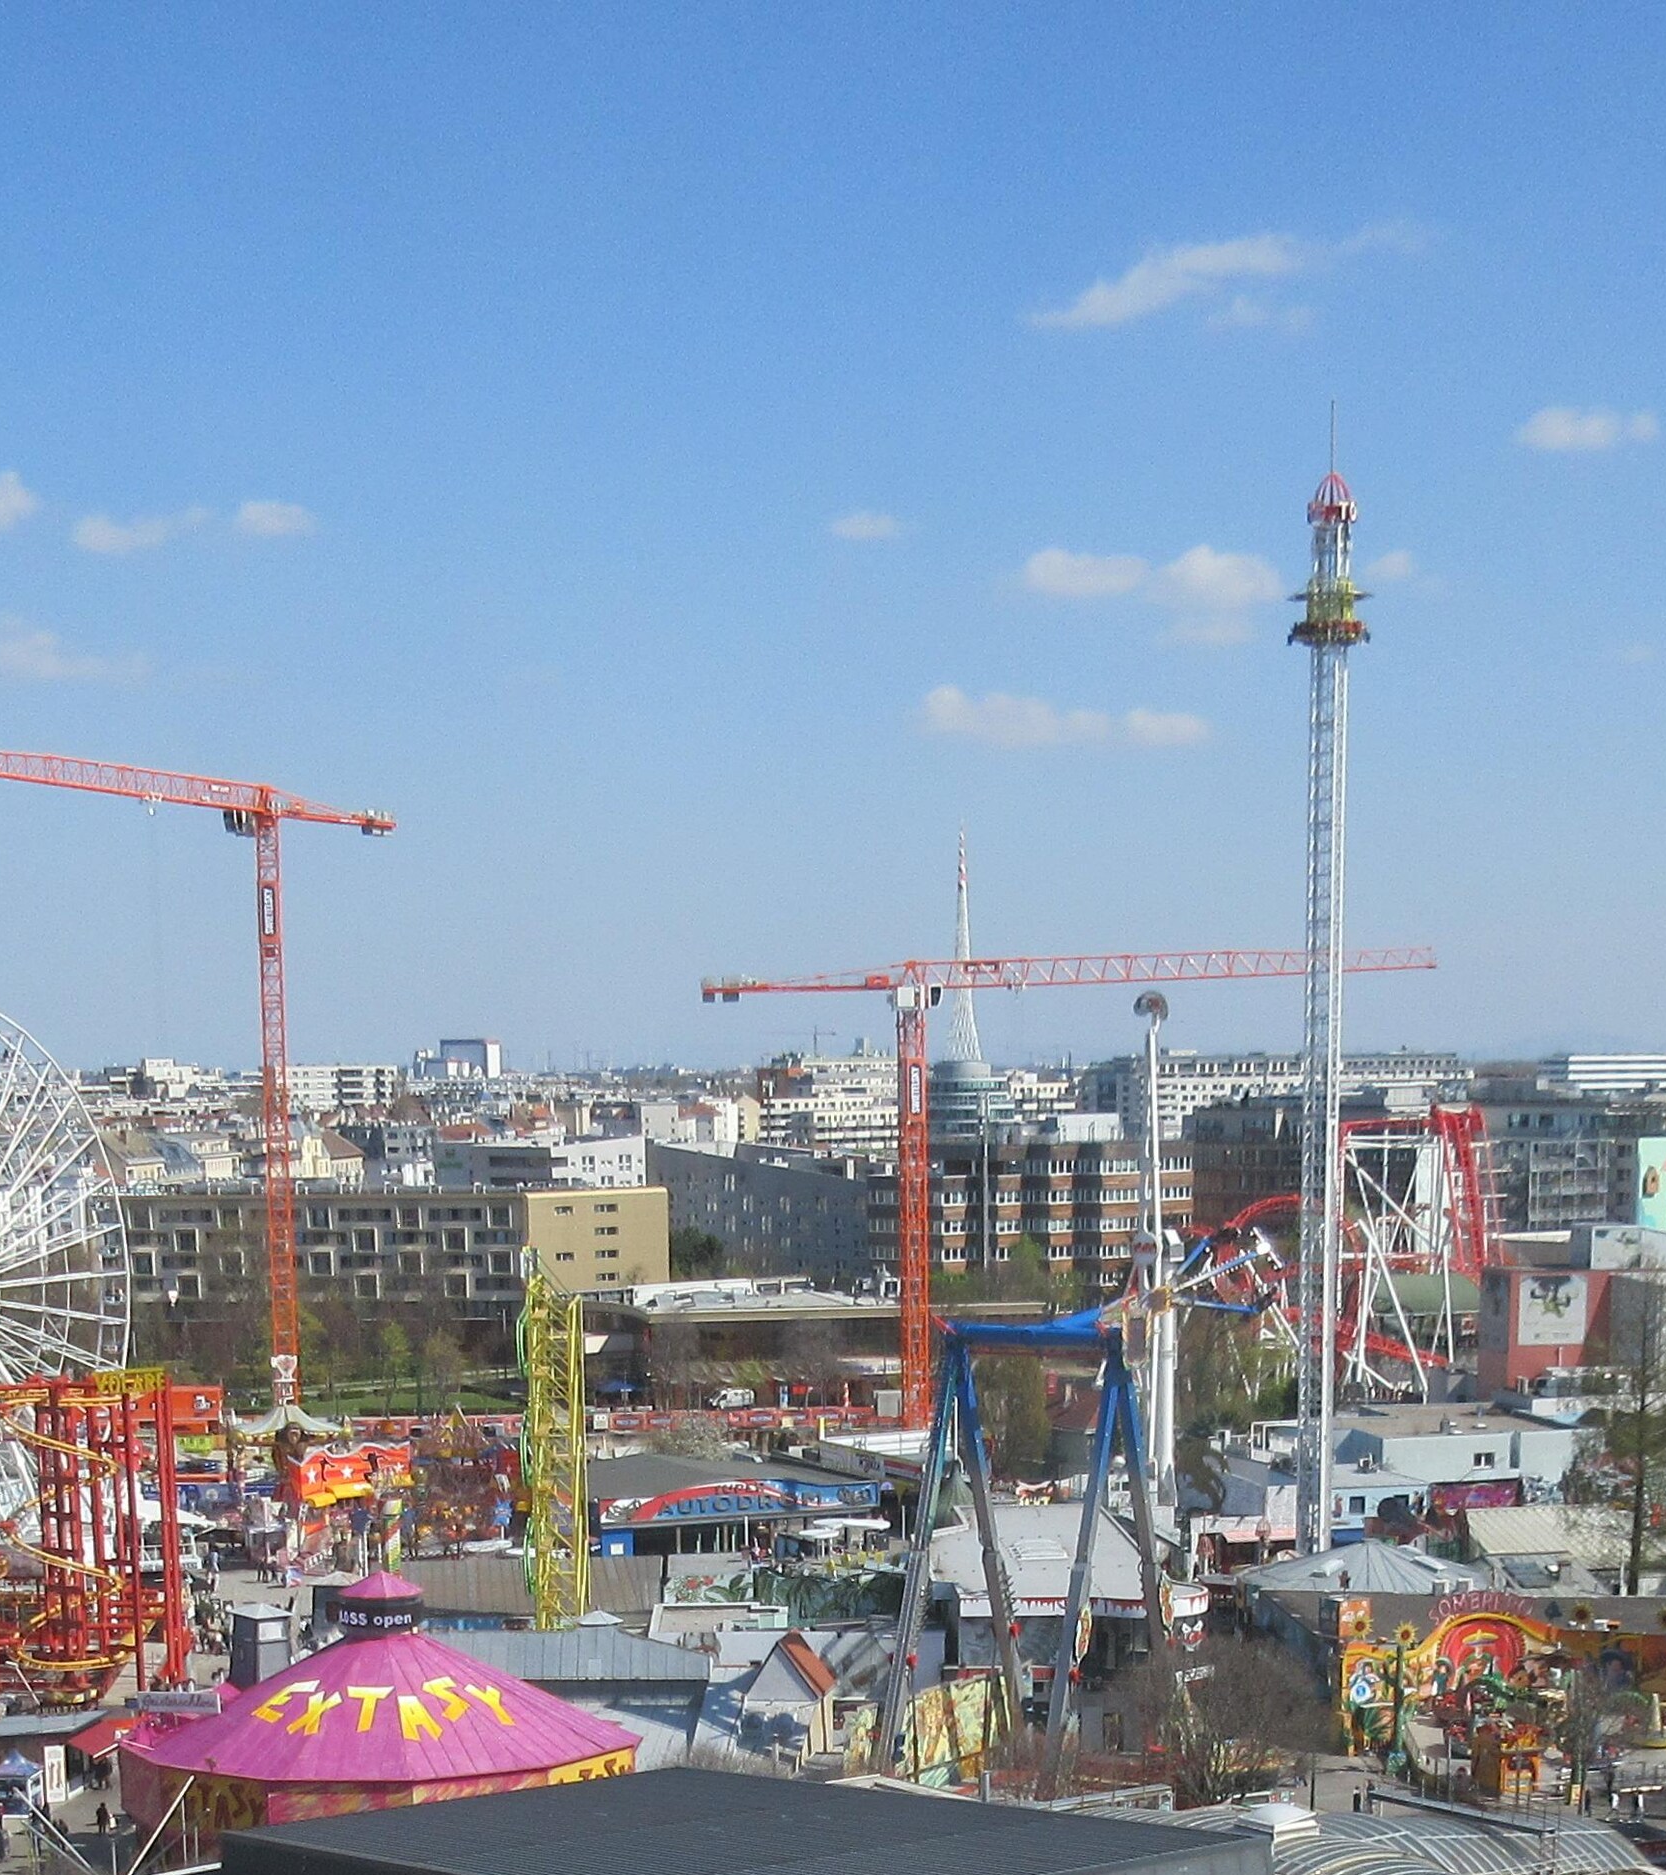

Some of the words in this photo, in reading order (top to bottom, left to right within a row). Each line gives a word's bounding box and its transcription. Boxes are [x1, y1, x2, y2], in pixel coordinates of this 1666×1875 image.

[94, 1370, 165, 1396] VOLARE
[373, 1613, 412, 1628] open
[252, 1676, 516, 1741] EXTASY
